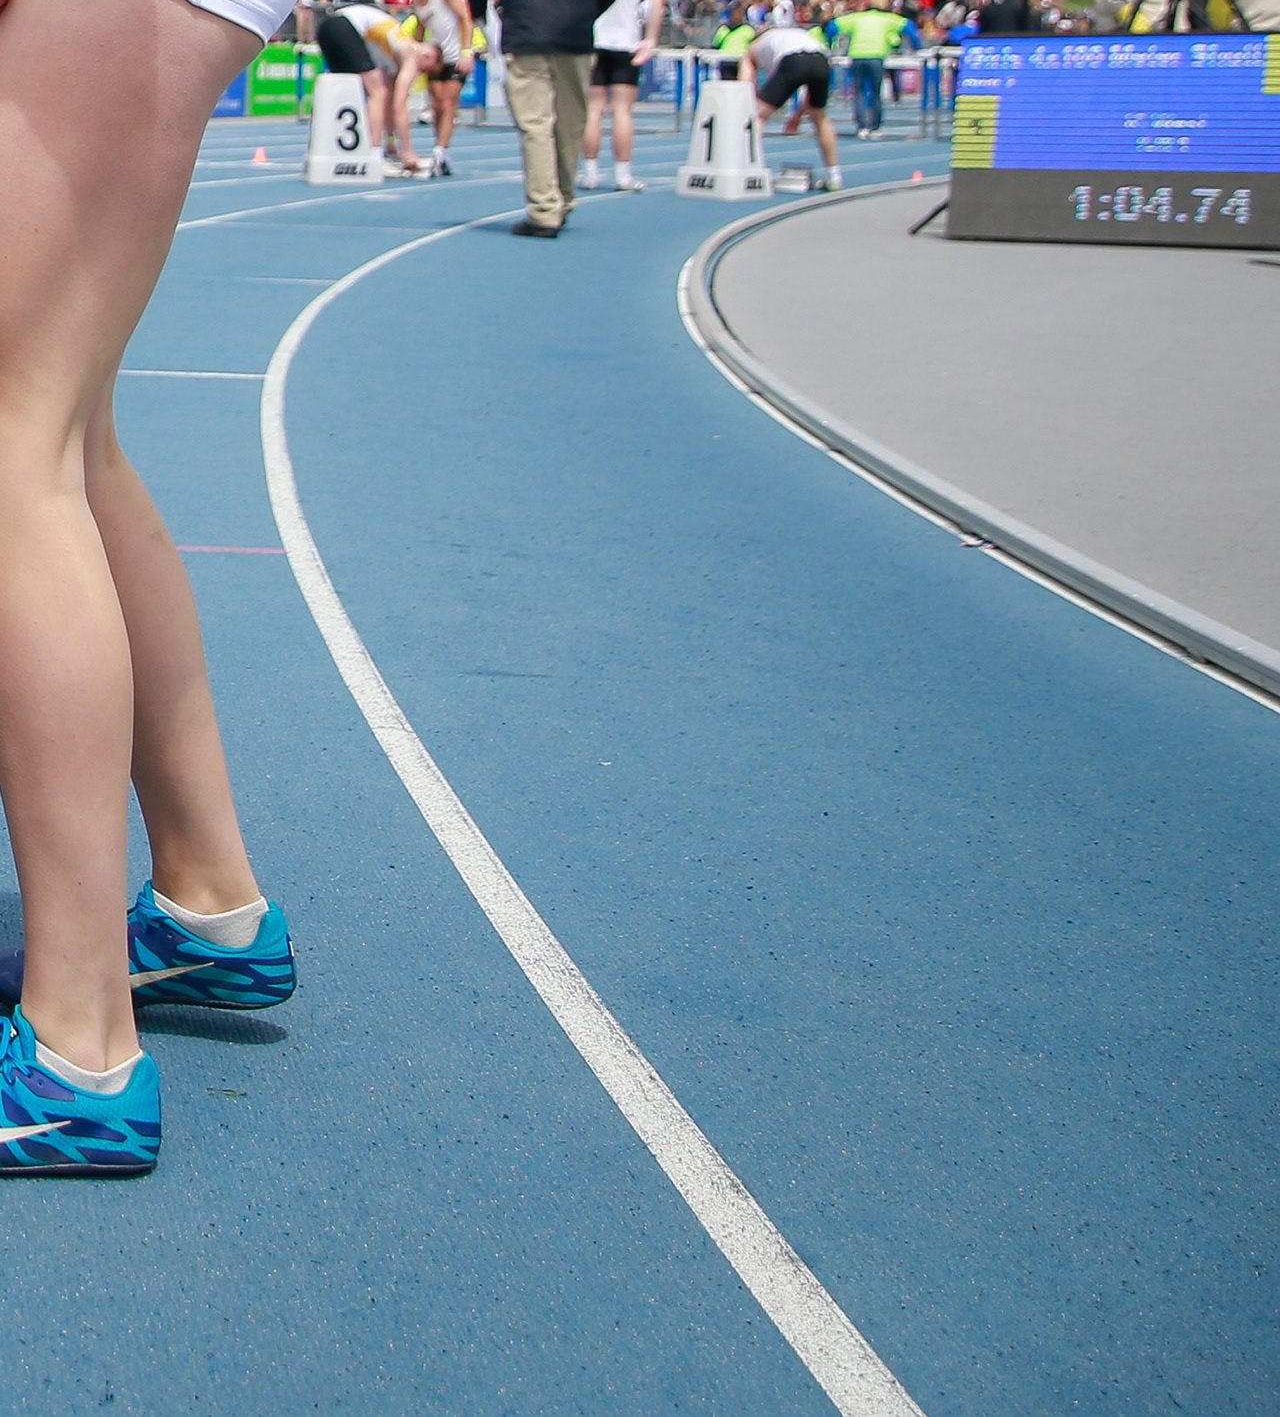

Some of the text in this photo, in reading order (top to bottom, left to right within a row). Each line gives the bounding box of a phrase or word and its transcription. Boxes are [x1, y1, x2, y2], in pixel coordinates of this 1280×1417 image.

[337, 108, 360, 151] 3
[700, 114, 716, 163] 1
[743, 116, 754, 163] 1
[334, 162, 368, 176] GILL
[1068, 185, 1252, 224] 1:04.74
